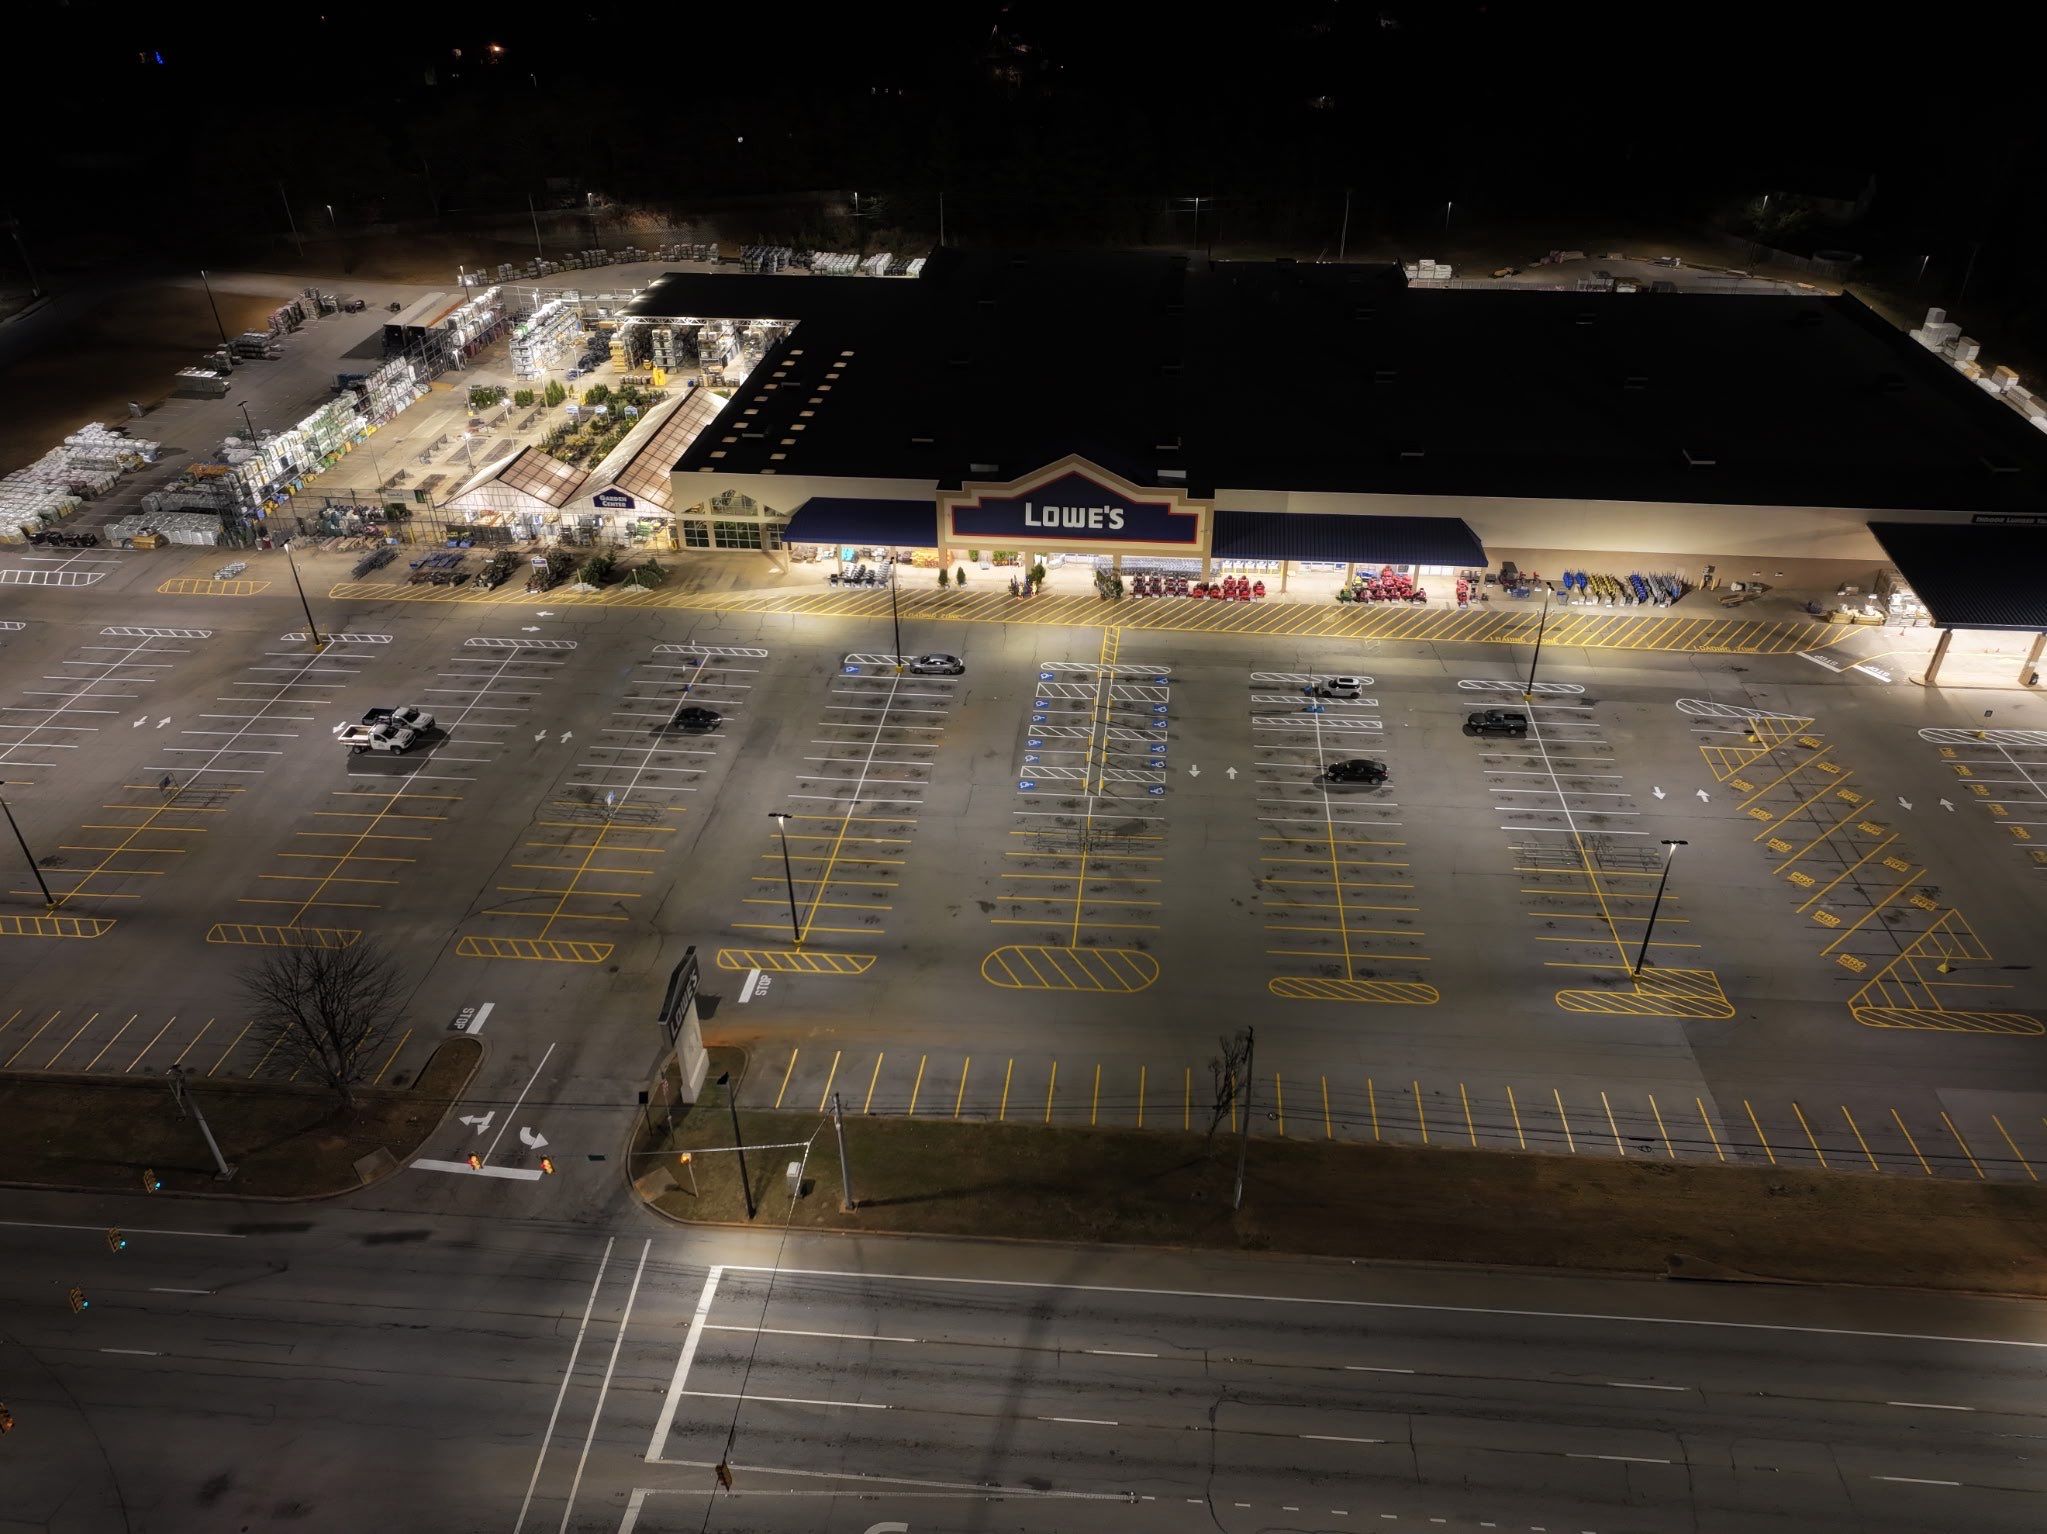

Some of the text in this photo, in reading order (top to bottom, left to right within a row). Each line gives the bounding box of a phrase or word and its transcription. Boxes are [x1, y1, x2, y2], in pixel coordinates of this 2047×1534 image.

[1024, 501, 1125, 530] LOWE'S
[755, 974, 772, 996] STOP
[670, 969, 697, 1039] LOWE'S
[454, 1007, 475, 1029] STOP
